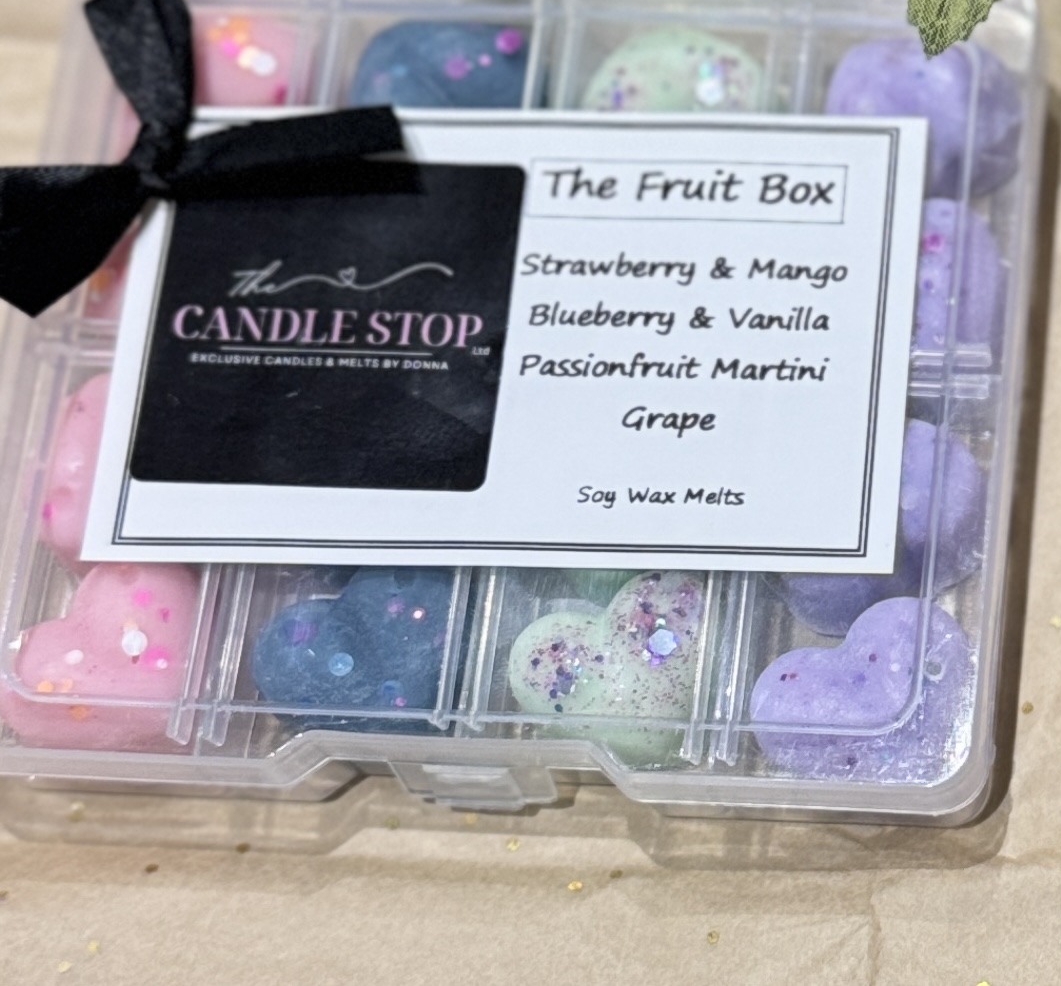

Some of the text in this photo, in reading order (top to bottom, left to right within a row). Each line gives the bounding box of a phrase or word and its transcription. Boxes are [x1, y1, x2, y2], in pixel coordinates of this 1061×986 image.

[543, 168, 835, 205] The Fruit Box
[228, 260, 284, 298] The
[520, 252, 848, 289] Strawberry & Mango
[173, 304, 482, 348] CANDLE STOP
[529, 301, 829, 335] Blueberry & Vanilla
[191, 352, 449, 371] EXCLUSIVE CANDLES & MELTS BY DONNA
[520, 352, 829, 381] Passionfruit Martini
[622, 406, 715, 438] Grape
[577, 486, 744, 509] Soy Wax Melts
